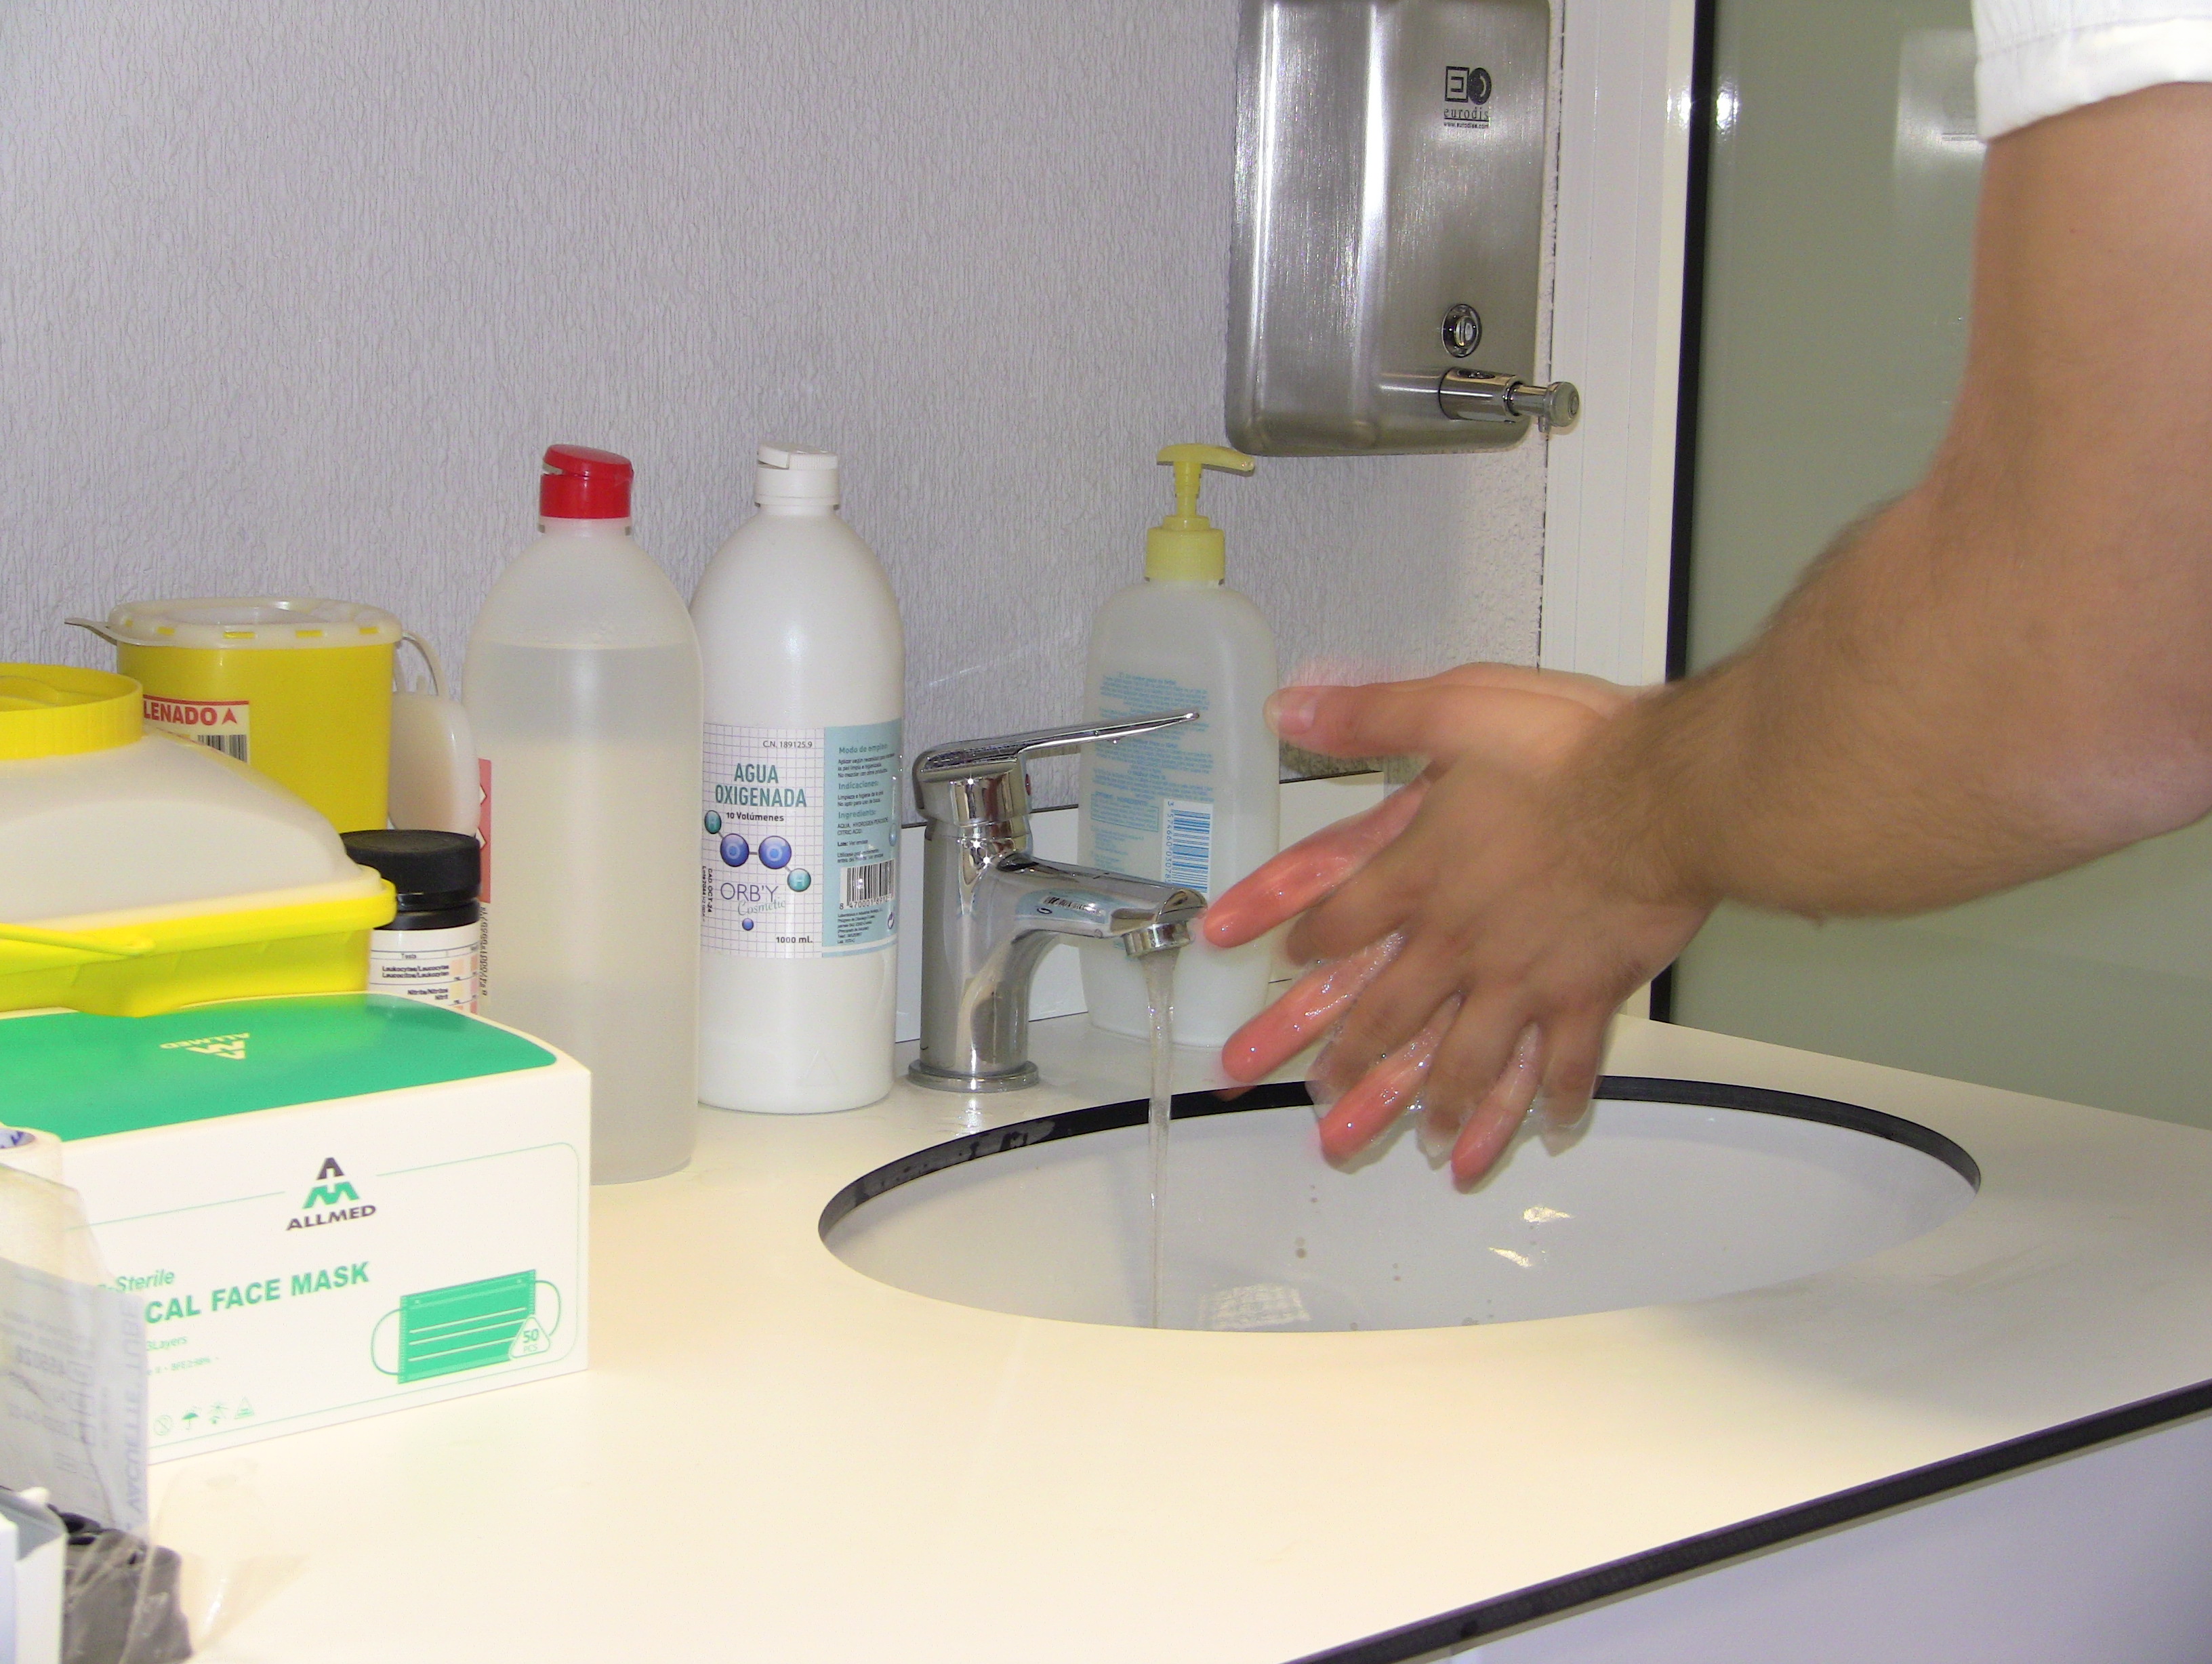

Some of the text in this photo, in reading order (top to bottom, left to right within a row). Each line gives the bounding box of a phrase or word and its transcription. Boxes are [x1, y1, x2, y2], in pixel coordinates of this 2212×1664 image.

[1443, 106, 1489, 120] eurodis
[734, 763, 779, 784] AGUA
[715, 784, 807, 808] OXIGENADA
[737, 812, 784, 822] Volúmenes
[1166, 813, 1174, 847] 574660
[737, 897, 786, 915] Cosmetic
[286, 1205, 376, 1231] ALLMED
[144, 1261, 369, 1323] CAL FACE MASK
[523, 1327, 539, 1344] 50
[523, 1344, 538, 1353] PCS
